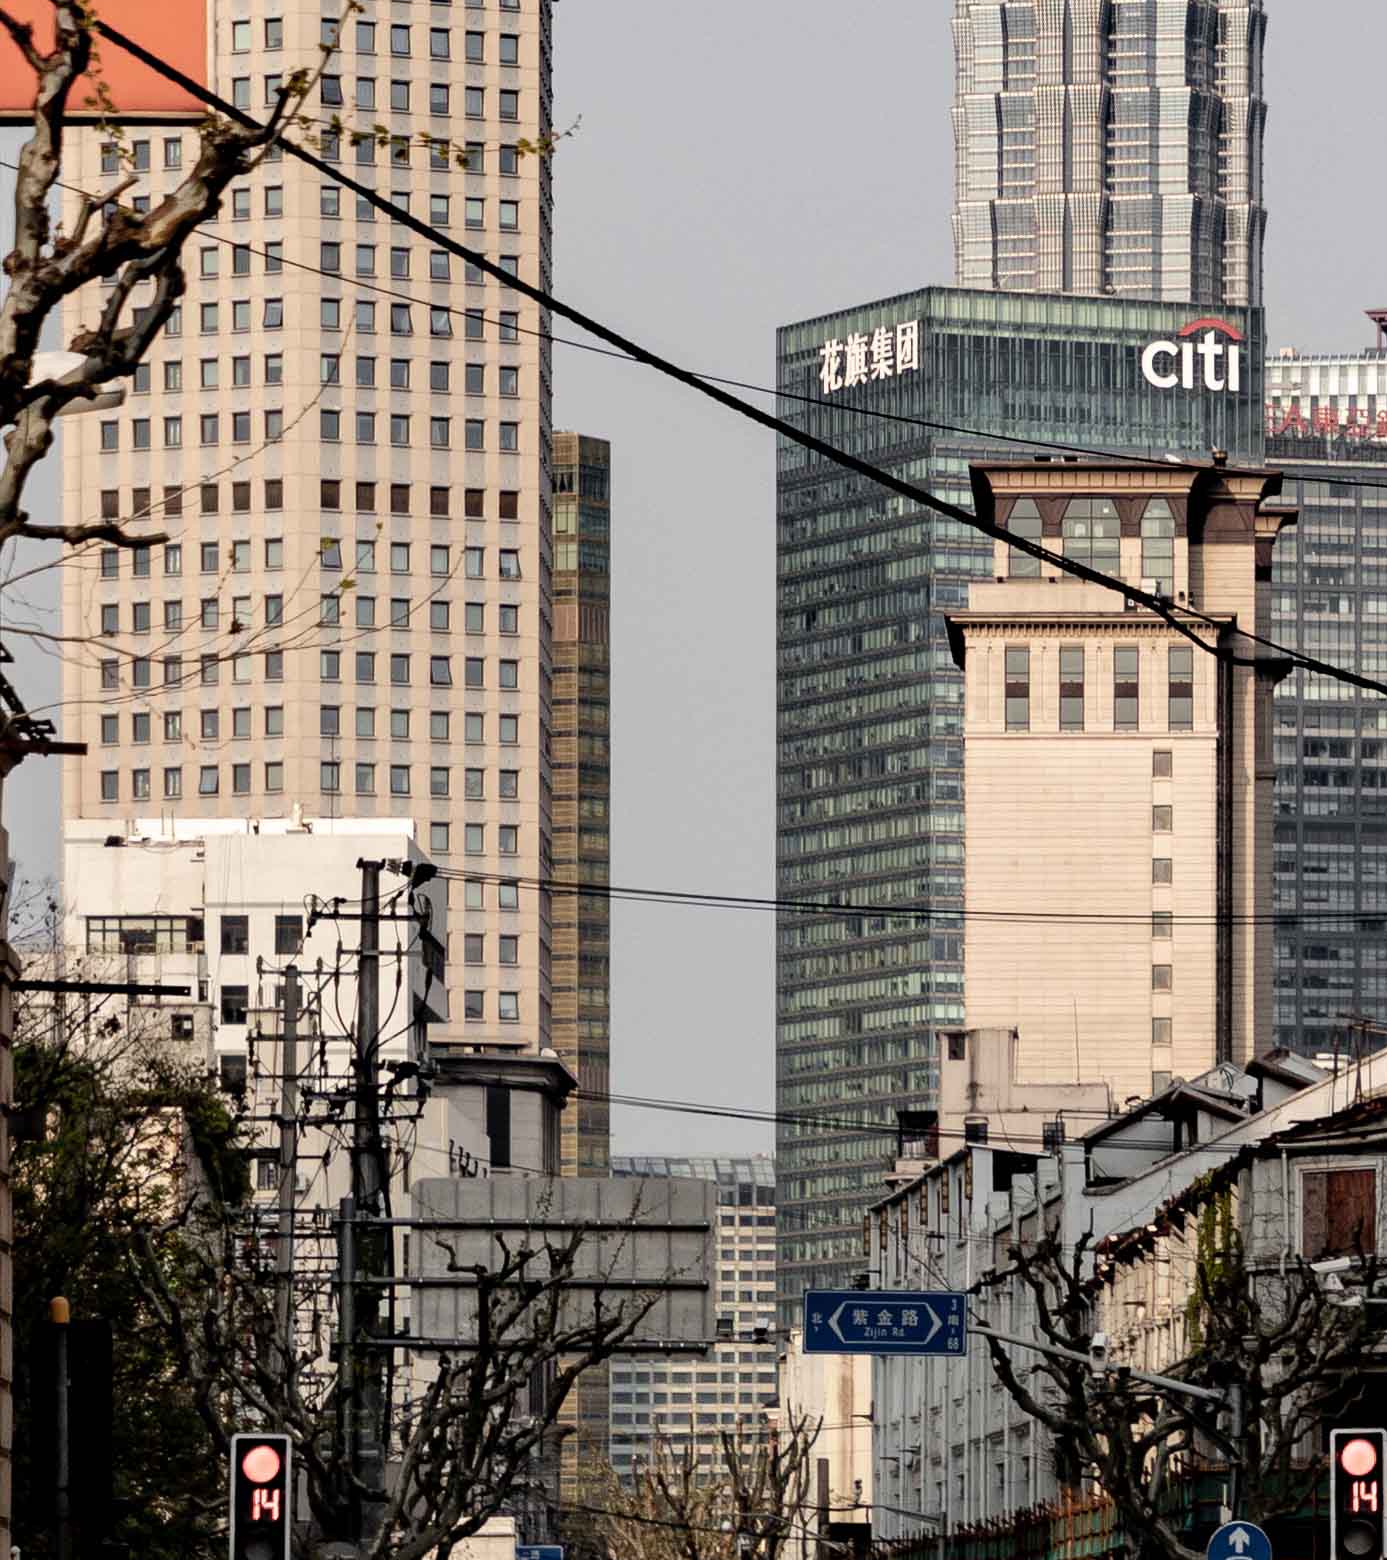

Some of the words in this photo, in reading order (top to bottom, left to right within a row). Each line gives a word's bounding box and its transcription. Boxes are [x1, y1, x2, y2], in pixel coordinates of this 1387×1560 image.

[818, 321, 919, 394] 花旗集团
[1141, 330, 1239, 392] citi
[852, 1309, 919, 1326] 紫金路
[864, 1327, 888, 1339] Zijin
[252, 1488, 280, 1521] 14
[1352, 1481, 1377, 1512] 14
